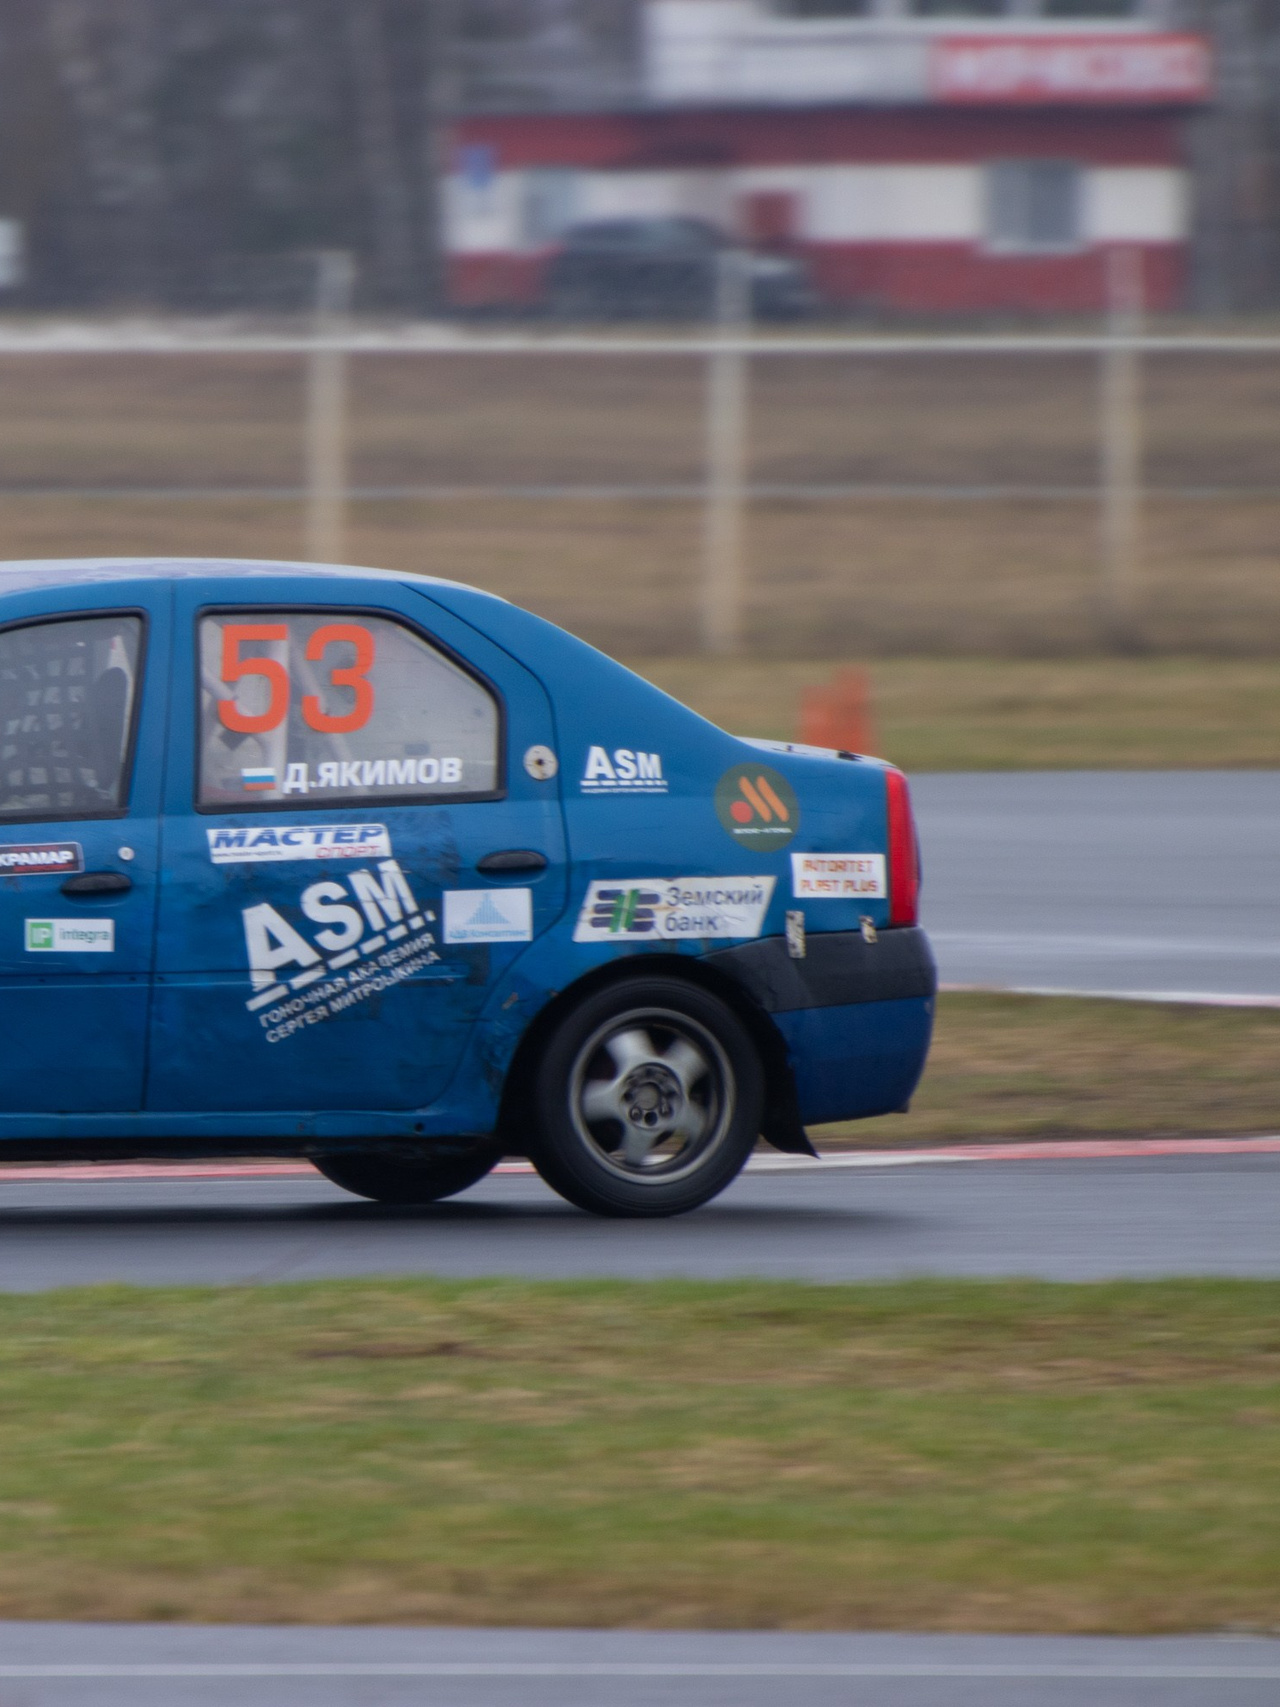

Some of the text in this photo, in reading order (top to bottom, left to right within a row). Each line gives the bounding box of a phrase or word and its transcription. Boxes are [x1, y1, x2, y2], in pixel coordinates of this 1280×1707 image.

[217, 624, 376, 733] 53
[283, 757, 463, 794] Д.ЯКИМОВ
[584, 745, 662, 779] ASM
[213, 825, 386, 849] МАСТЕР
[666, 884, 763, 906] Земский
[843, 879, 878, 892] PLUS
[60, 928, 110, 944] integra
[241, 859, 419, 991] ASM
[665, 912, 718, 932] банк
[259, 977, 347, 1027] ГОНОЧНАЯ
[265, 1004, 329, 1043] СЕРГЕЯ
